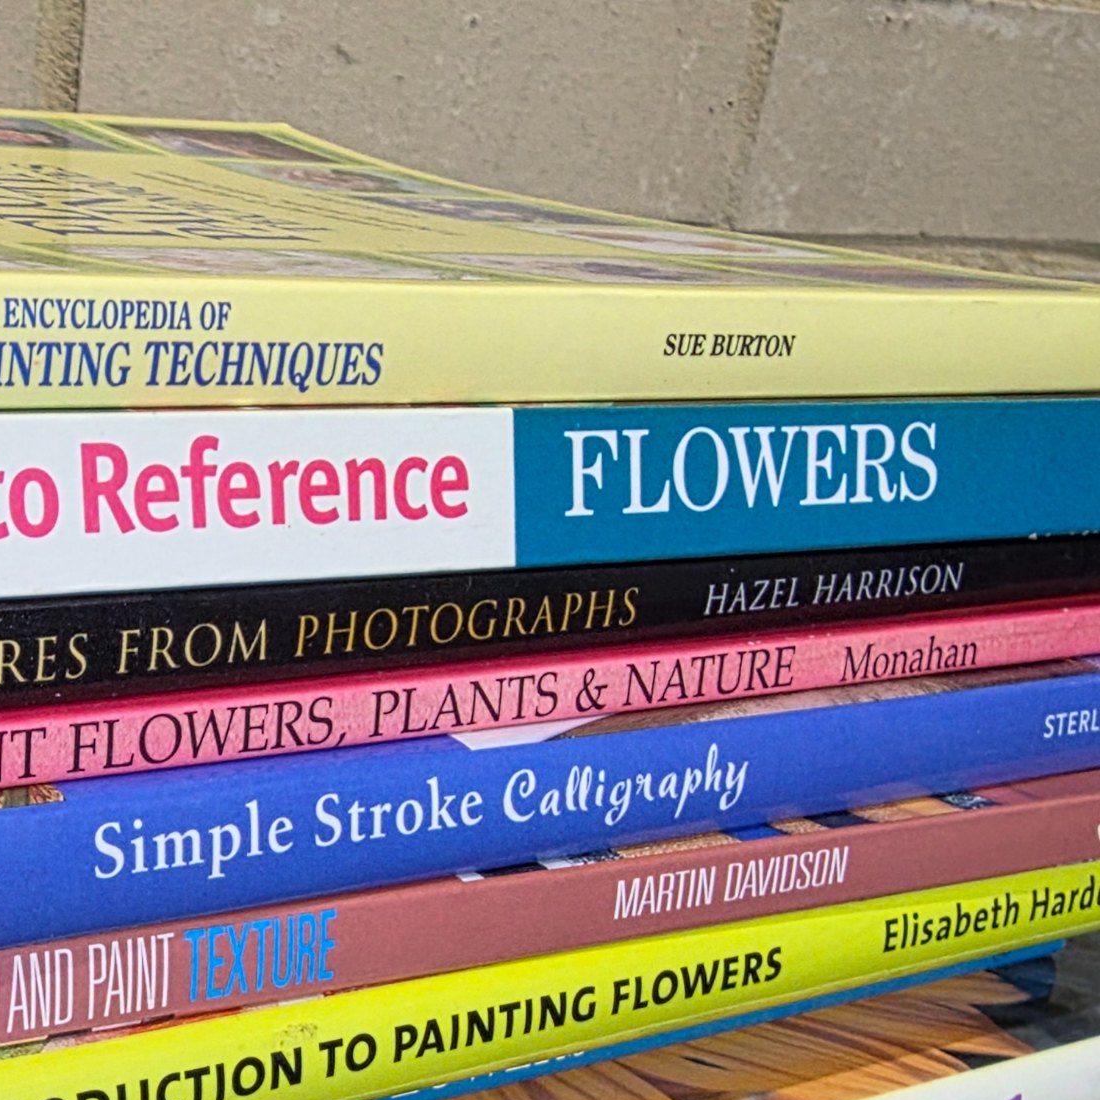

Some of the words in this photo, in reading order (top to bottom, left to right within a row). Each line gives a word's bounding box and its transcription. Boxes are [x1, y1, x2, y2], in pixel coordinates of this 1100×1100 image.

[3, 297, 192, 331] ENCYCLOPEDIA
[199, 301, 232, 331] OF
[663, 333, 707, 358] SUE
[709, 333, 796, 358] BURTON
[143, 341, 385, 393] TECHNIQUES
[80, 435, 469, 534] Reference
[564, 421, 939, 517] FLOWERS
[702, 575, 800, 617] HAZEL
[811, 562, 965, 606] HARRISON
[116, 617, 269, 675] FROM
[295, 587, 640, 658] PHOTOGRAPHS
[839, 635, 978, 685] Monahan
[67, 695, 347, 775] FLOWERS,
[369, 672, 560, 740] PLANTS
[575, 667, 608, 714] &
[621, 645, 797, 706] NATURE
[1043, 709, 1100, 739] STERL
[94, 800, 294, 880] Simple
[313, 776, 484, 849] Stroke
[502, 742, 749, 826] Calligraphy
[613, 868, 715, 921] MARTIN
[724, 845, 850, 904] DAVIDSON
[881, 892, 1020, 953] Elisabeth
[1029, 874, 1100, 922] Hard
[6, 947, 75, 1038] AND
[87, 932, 175, 1021] PAINT
[183, 908, 339, 1004] TEXTURE
[318, 1032, 378, 1078] TO
[393, 986, 597, 1063] PAINTING
[610, 946, 783, 1015] FLOWERS
